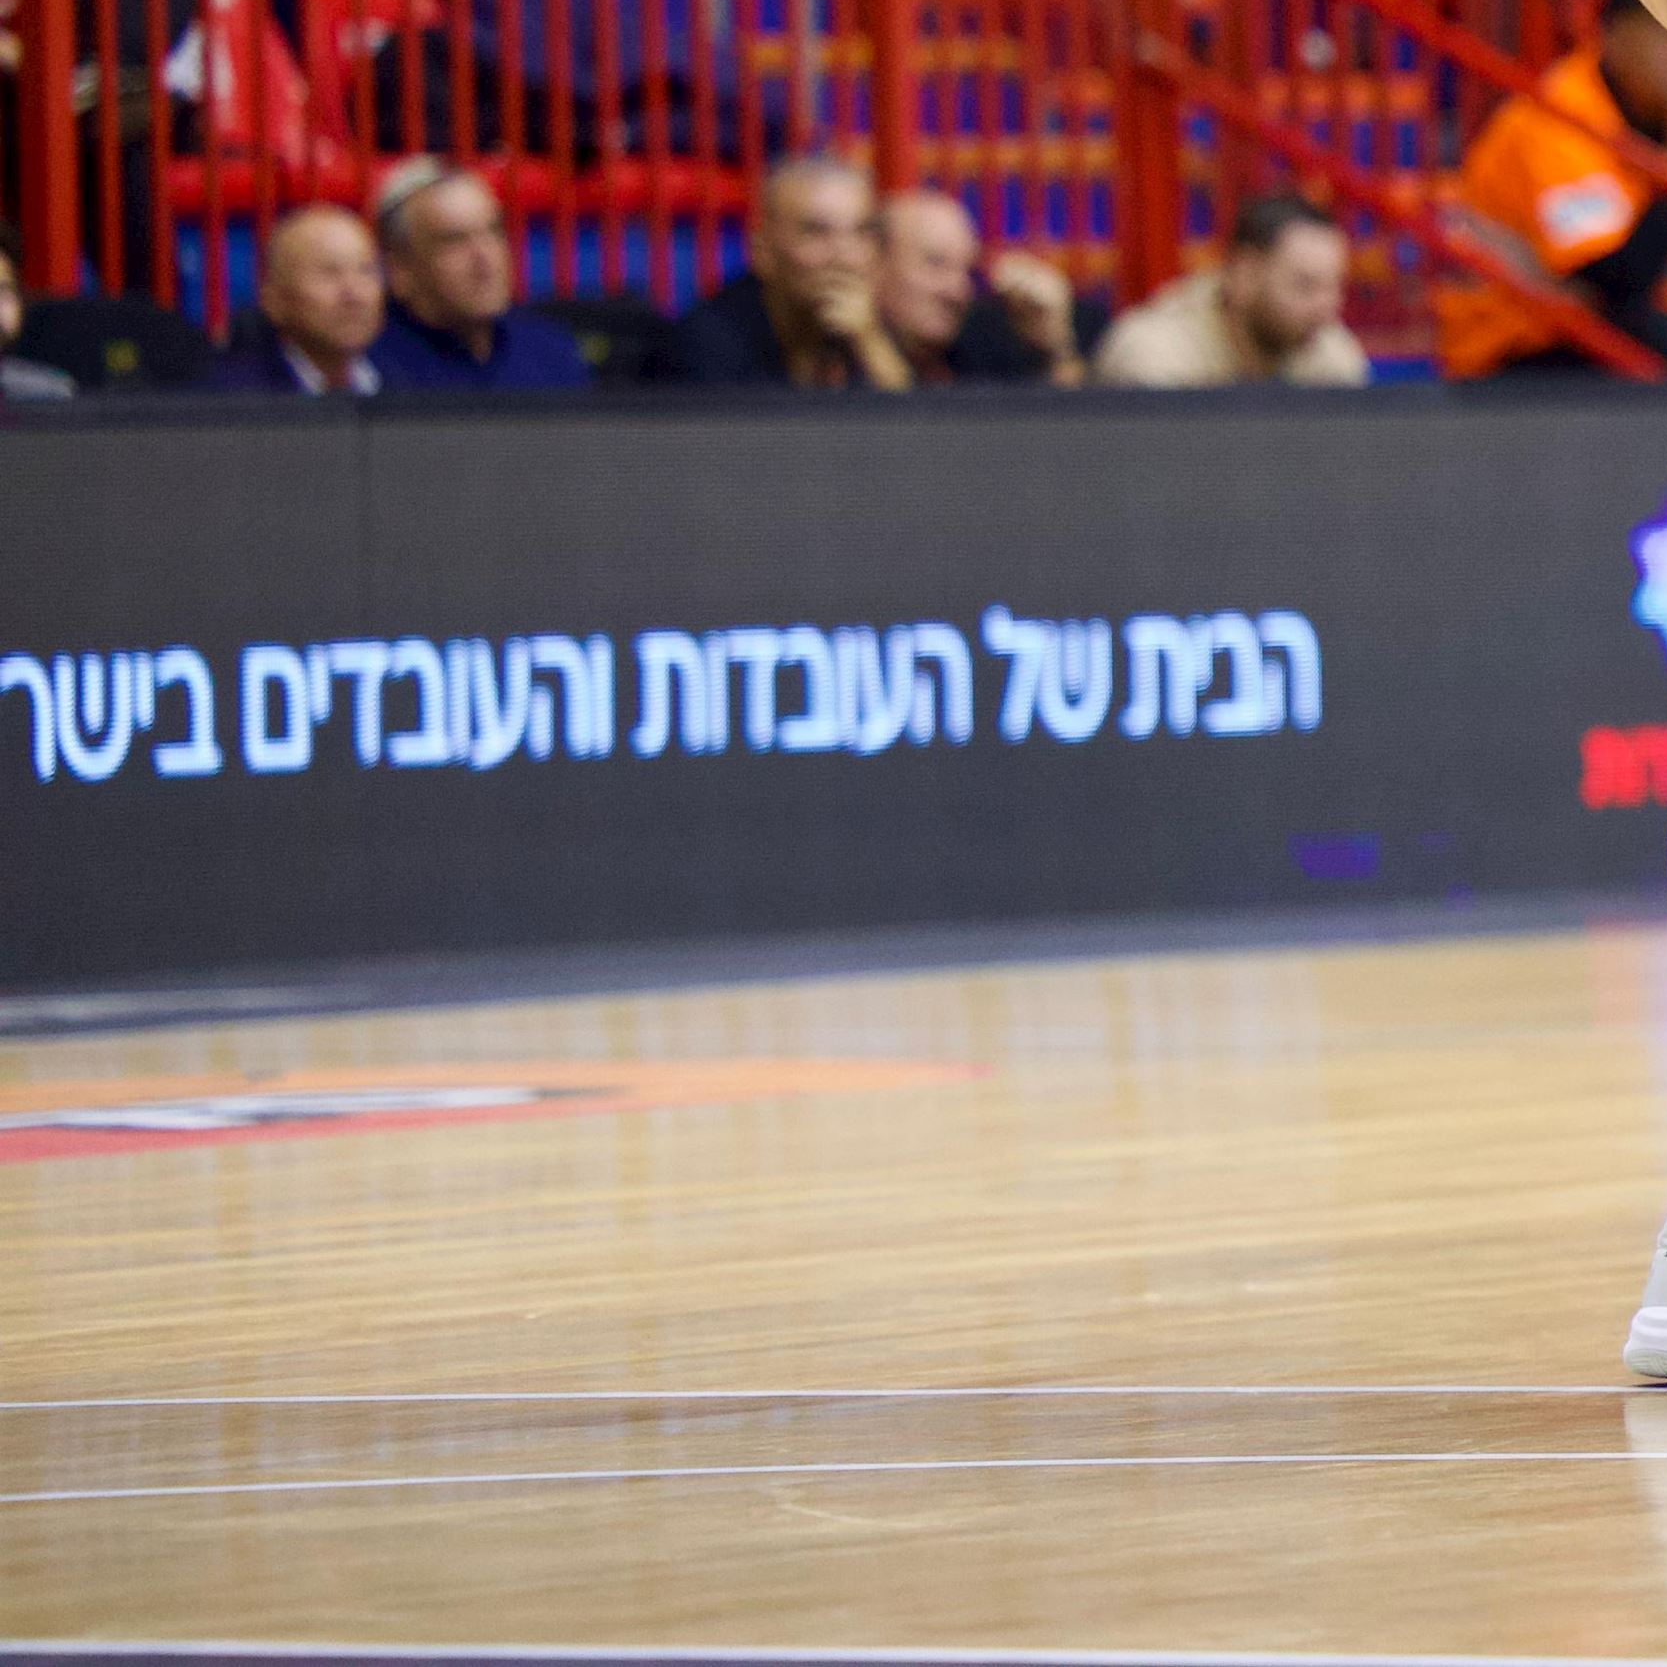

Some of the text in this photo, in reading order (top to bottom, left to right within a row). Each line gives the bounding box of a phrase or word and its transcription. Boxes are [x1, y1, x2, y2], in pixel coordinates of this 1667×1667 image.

[0, 603, 1323, 783] הבית של העובדות והעובדים בישר
